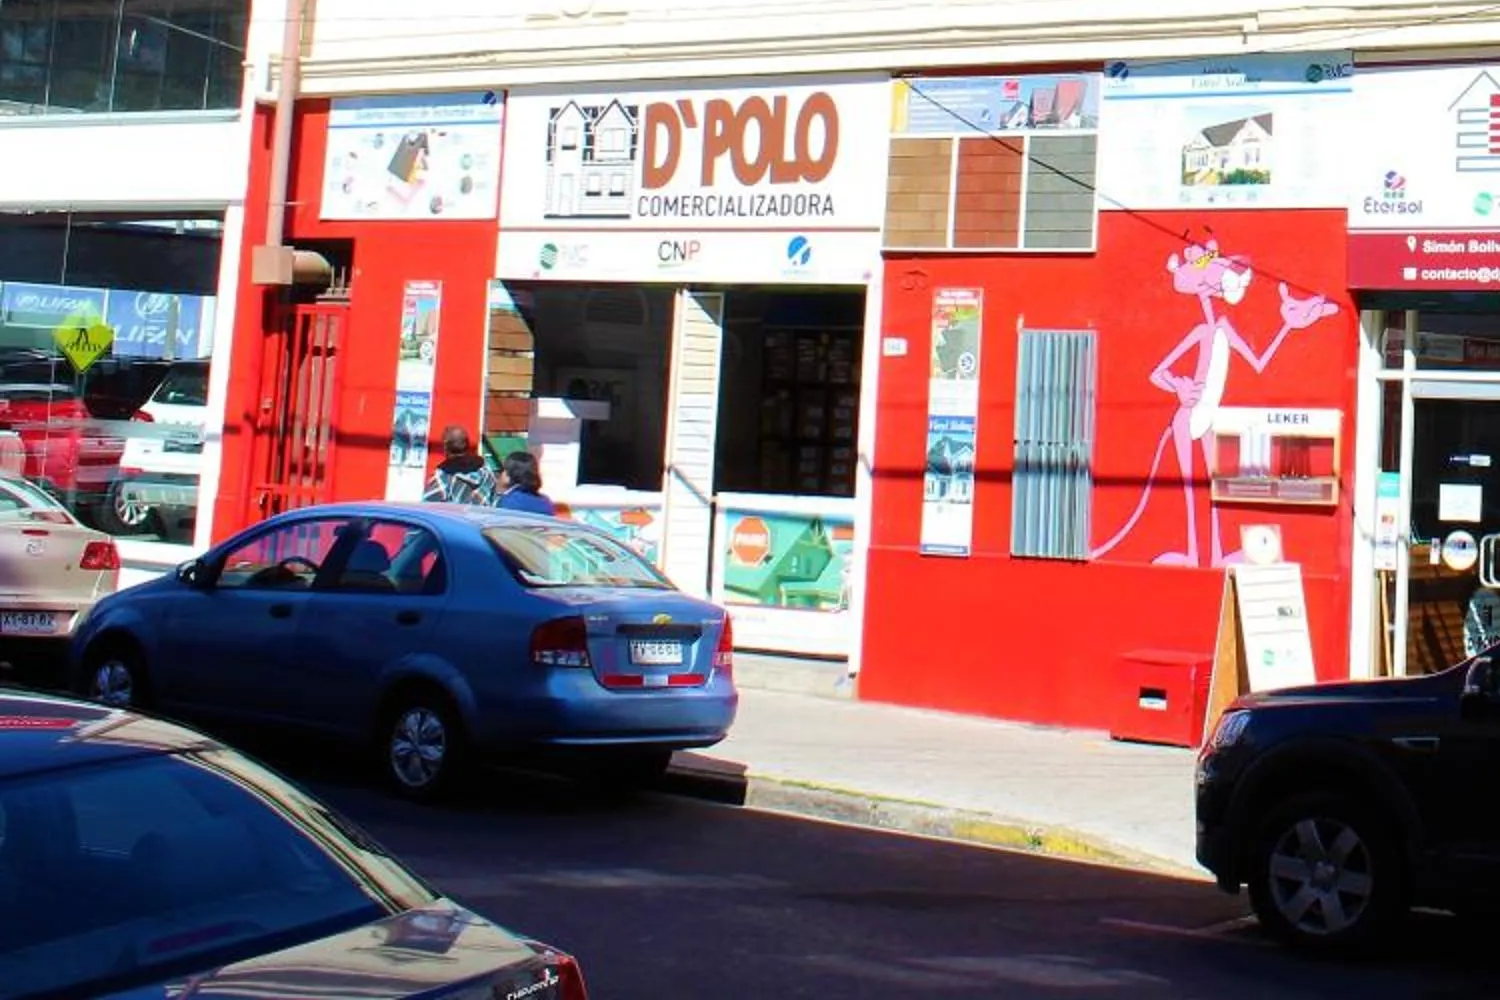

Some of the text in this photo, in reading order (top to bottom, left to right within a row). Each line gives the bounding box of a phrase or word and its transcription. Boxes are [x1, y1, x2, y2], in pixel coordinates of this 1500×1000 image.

[637, 193, 835, 217] COMERCIALIZADORA
[657, 240, 701, 262] CNP
[1267, 413, 1309, 424] LEKER
